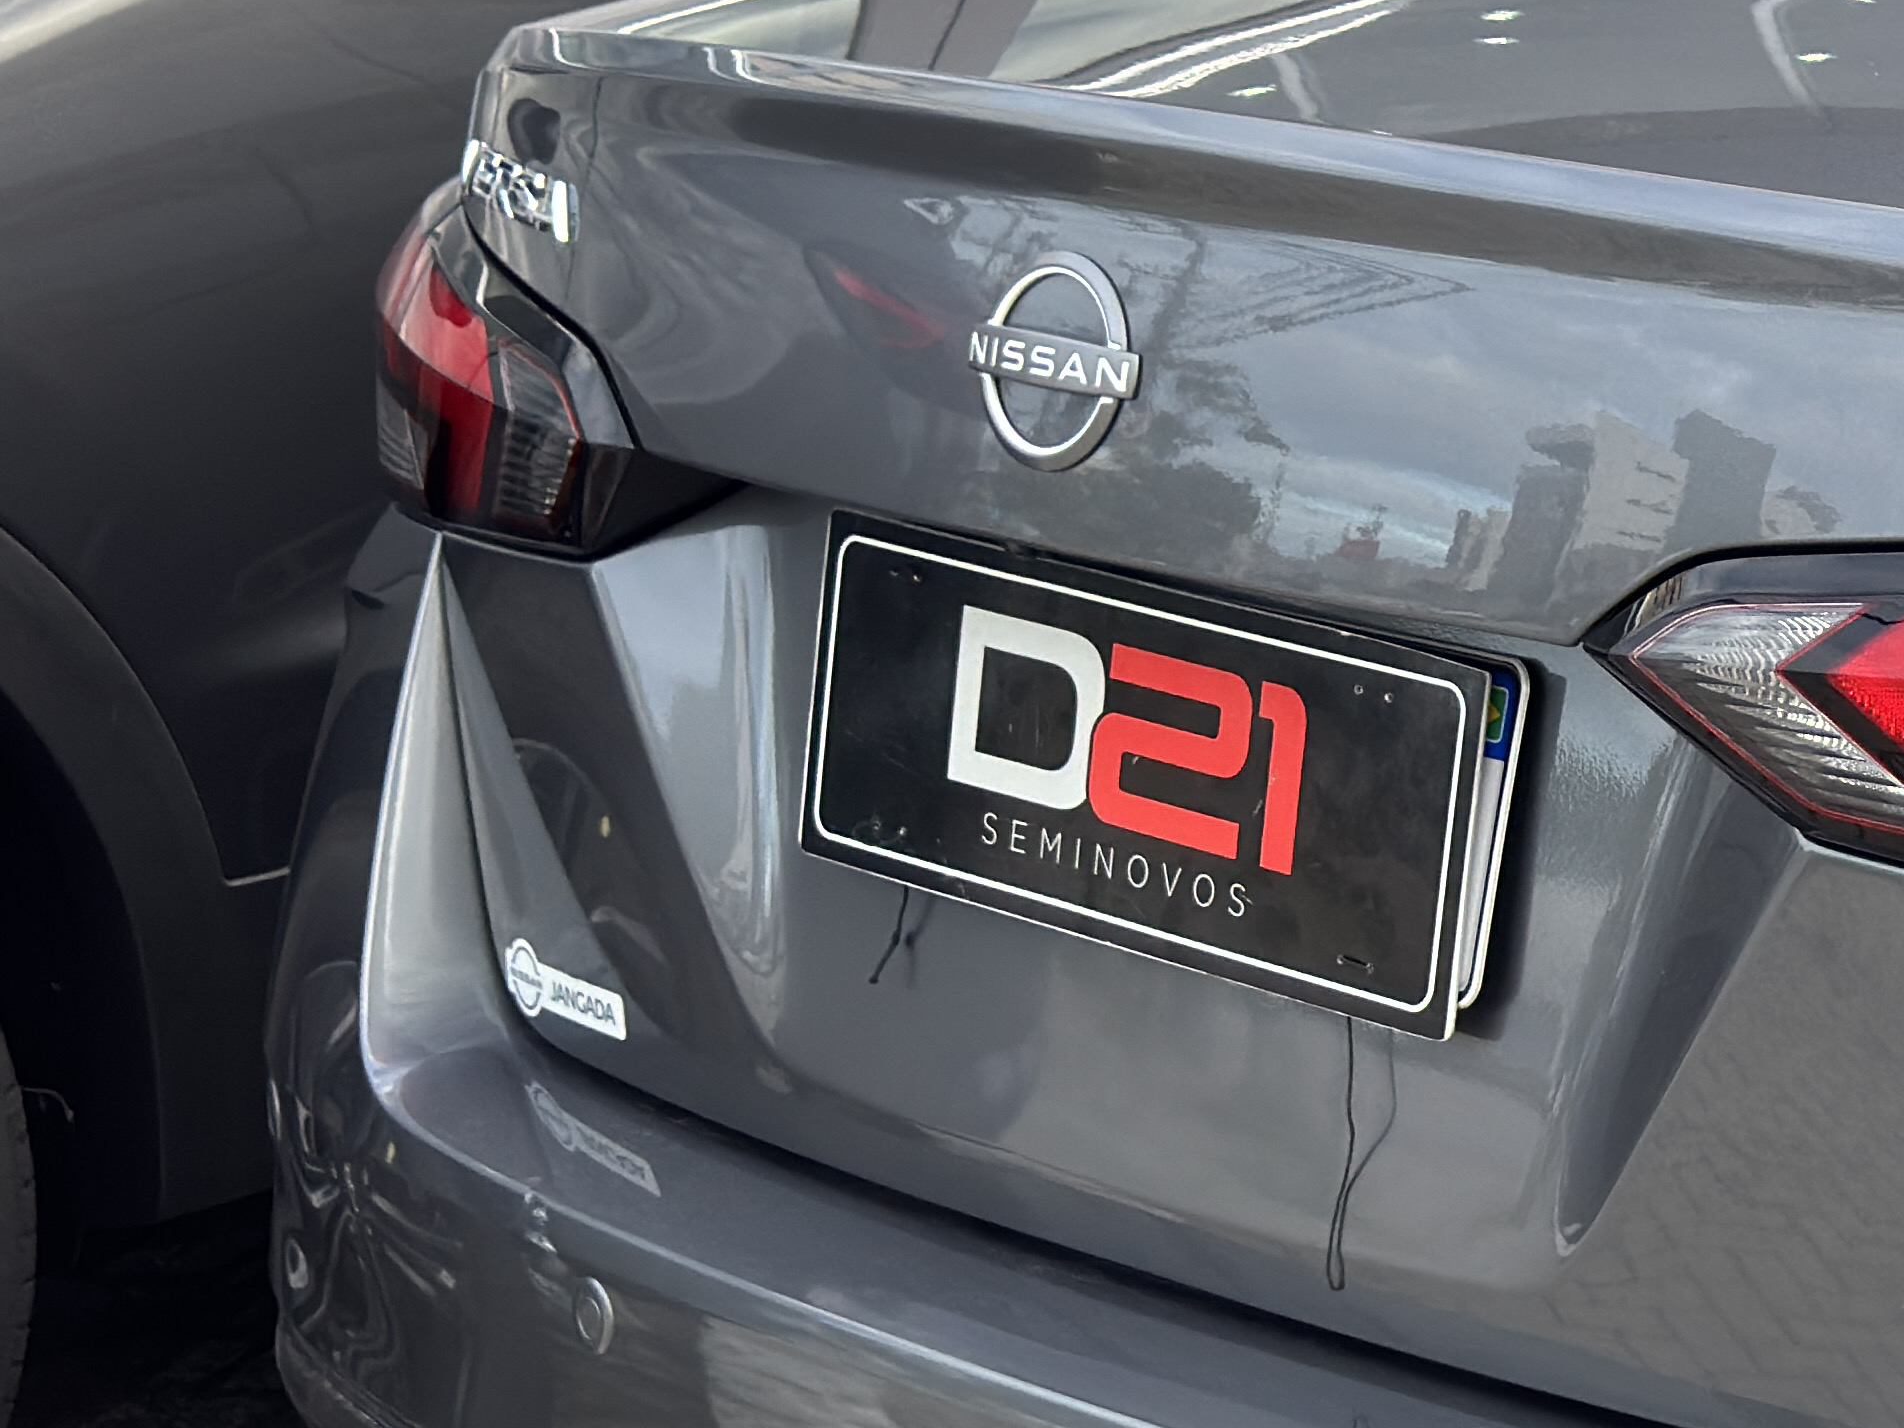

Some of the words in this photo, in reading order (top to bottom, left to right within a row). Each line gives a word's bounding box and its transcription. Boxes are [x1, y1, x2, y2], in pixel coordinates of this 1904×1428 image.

[968, 331, 1130, 392] NISSAN
[946, 604, 1308, 876] D21
[980, 811, 1248, 918] SEMINOVOS
